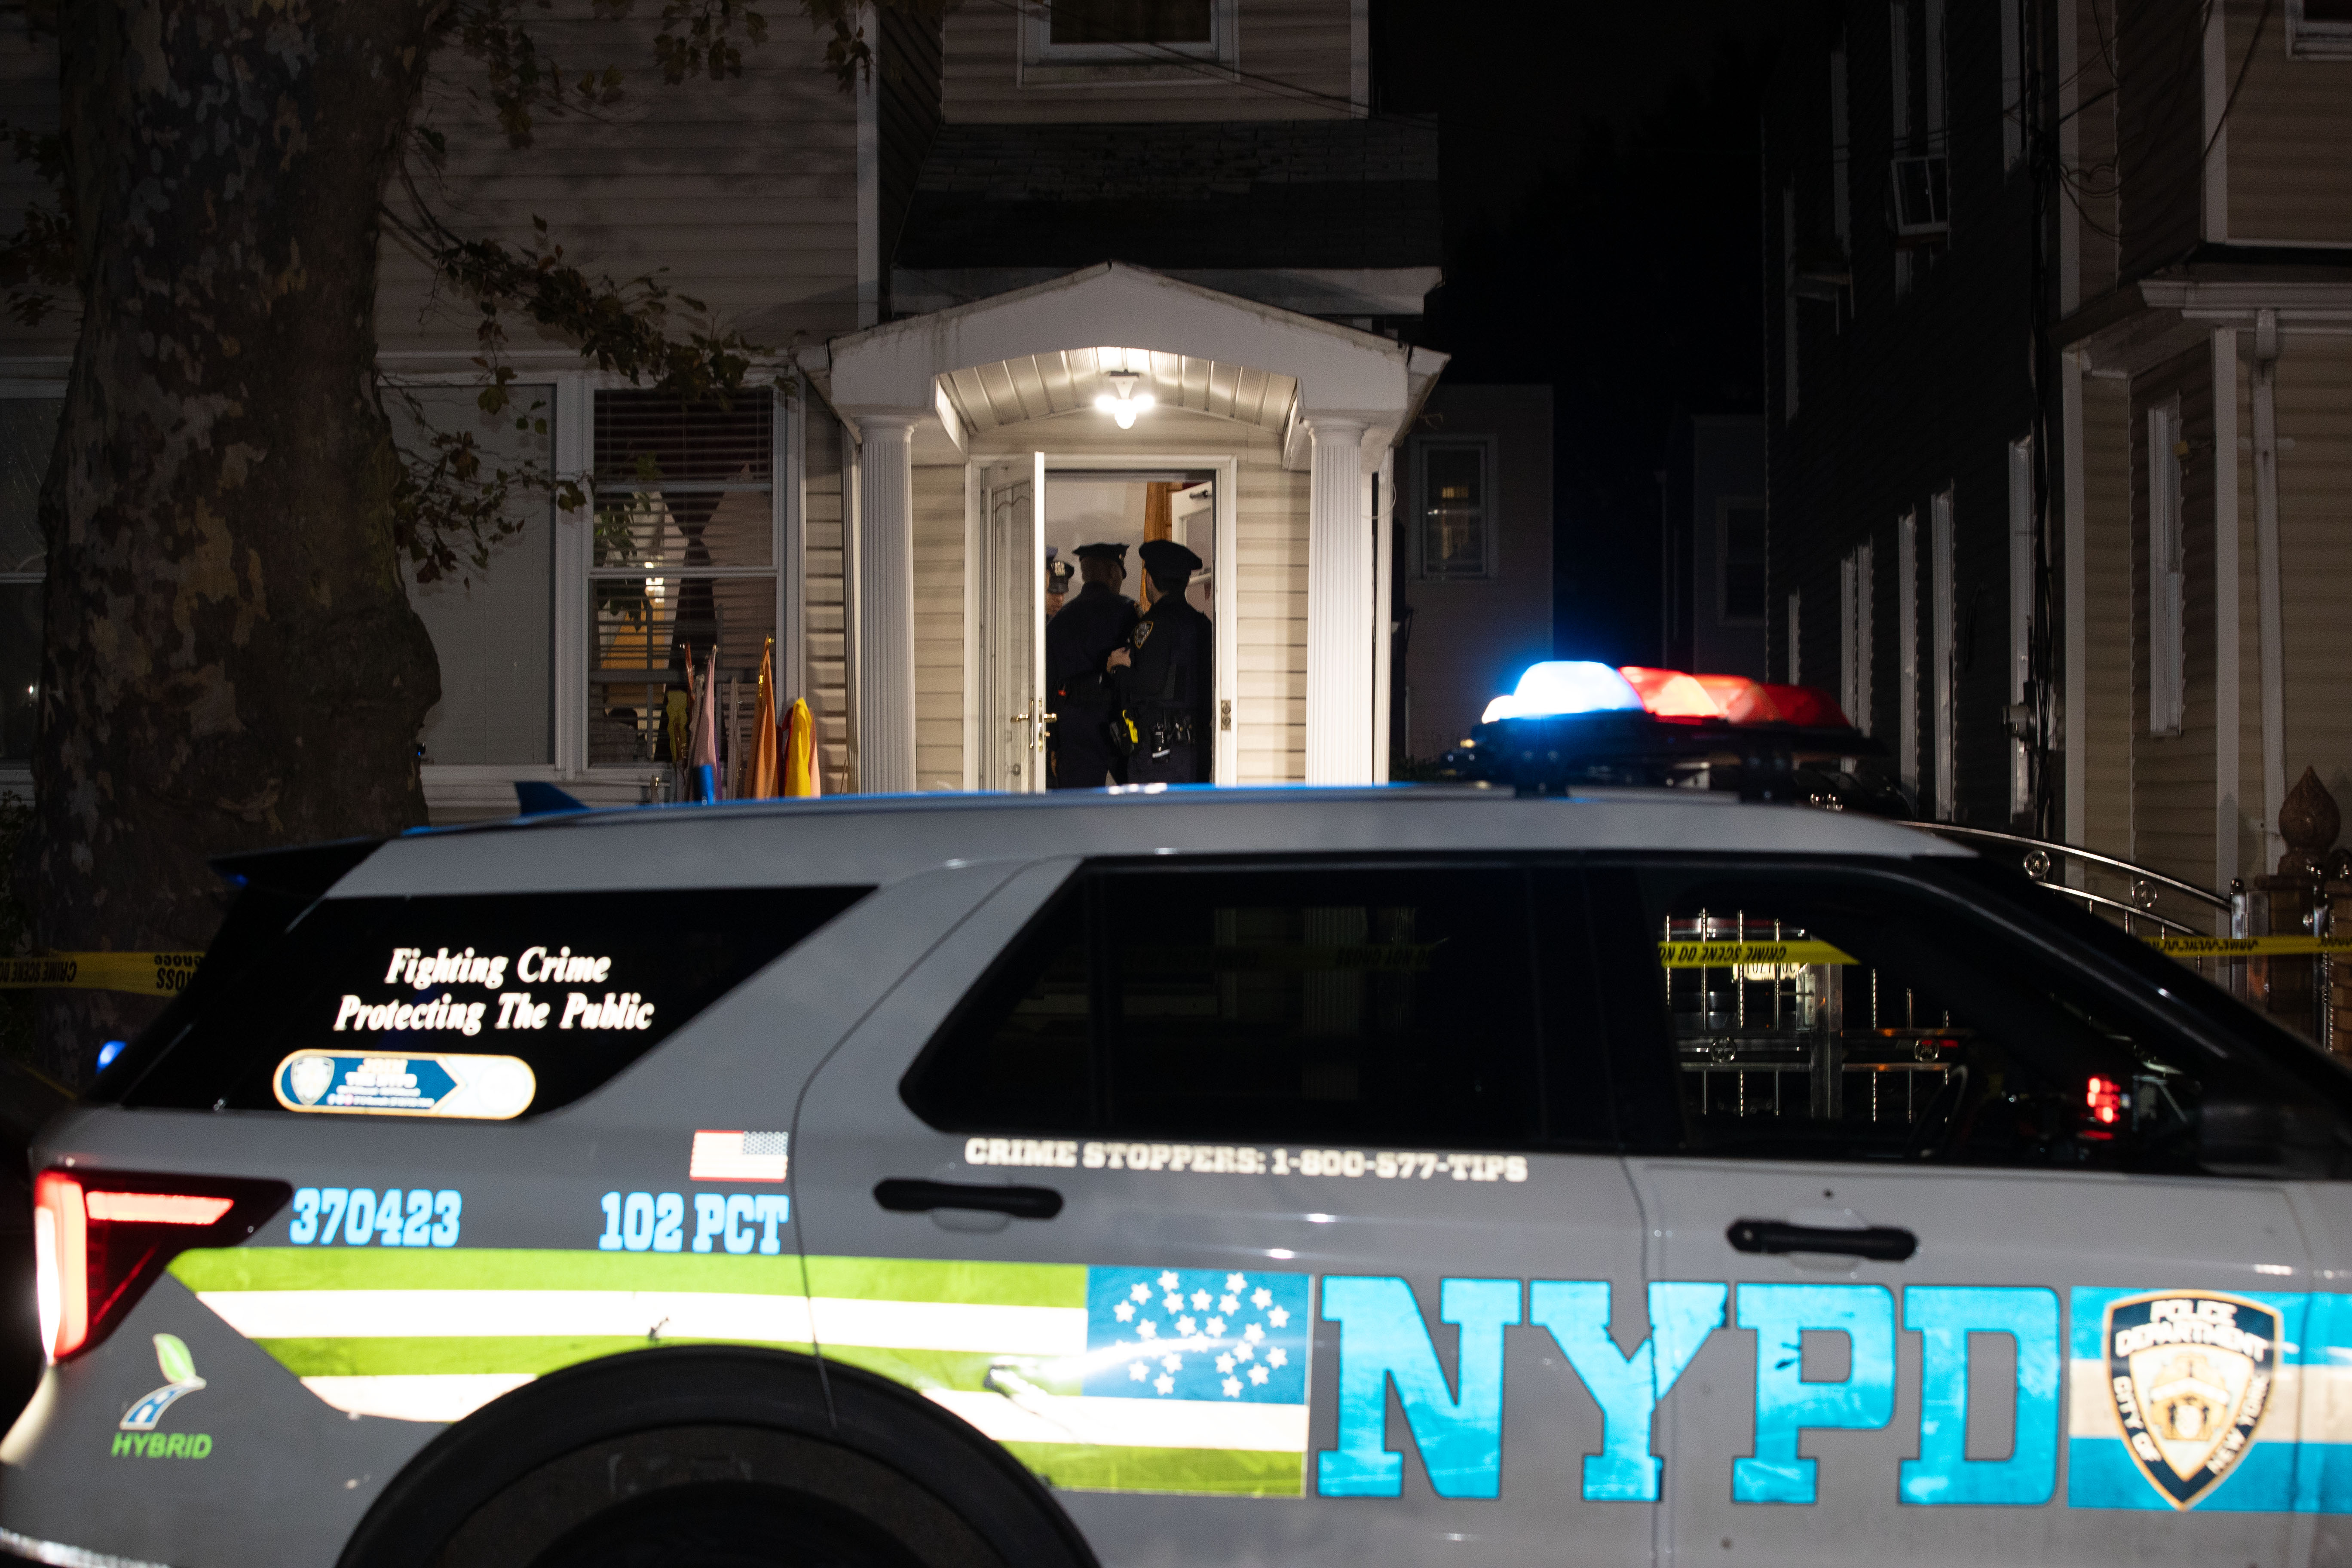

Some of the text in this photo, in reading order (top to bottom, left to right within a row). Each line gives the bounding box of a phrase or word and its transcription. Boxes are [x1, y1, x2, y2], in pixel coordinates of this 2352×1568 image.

[385, 946, 612, 990] Fighting Crime
[1659, 946, 1786, 961] CRIME SCENE DO NO
[334, 992, 655, 1036] Protecting The Public
[965, 1138, 1528, 1182] CRIME STOPPERS: 1-800-577-TIPS
[289, 1187, 463, 1247] 370423
[598, 1191, 790, 1255] 102 PCT
[2150, 1298, 2237, 1327] POLICE
[2115, 1321, 2269, 1362] DEPARTMENT
[1317, 1275, 2062, 1506] NYPD
[2113, 1376, 2162, 1461] CITY OF
[111, 1432, 213, 1460] HYBRID
